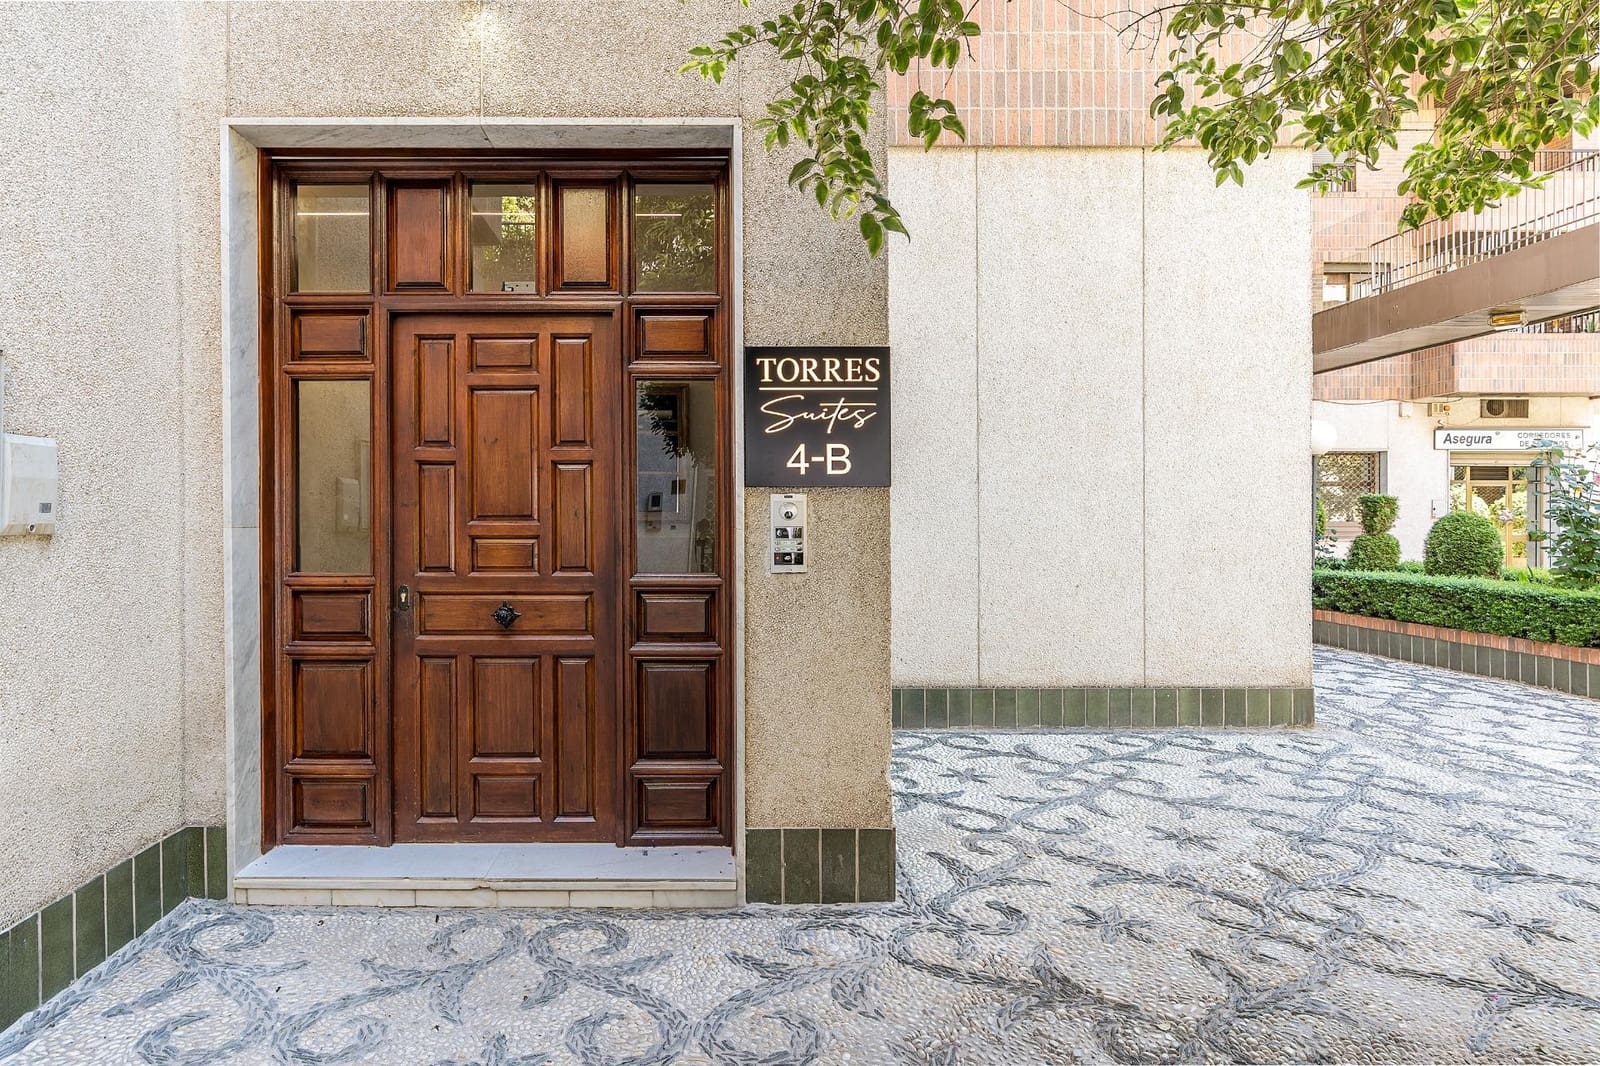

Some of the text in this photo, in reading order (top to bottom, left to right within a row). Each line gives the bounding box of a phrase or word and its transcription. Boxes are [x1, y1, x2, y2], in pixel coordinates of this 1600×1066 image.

[756, 358, 881, 383] TORRES
[760, 394, 877, 434] Suites
[1443, 432, 1493, 447] Asegura
[786, 443, 852, 475] 4-B
